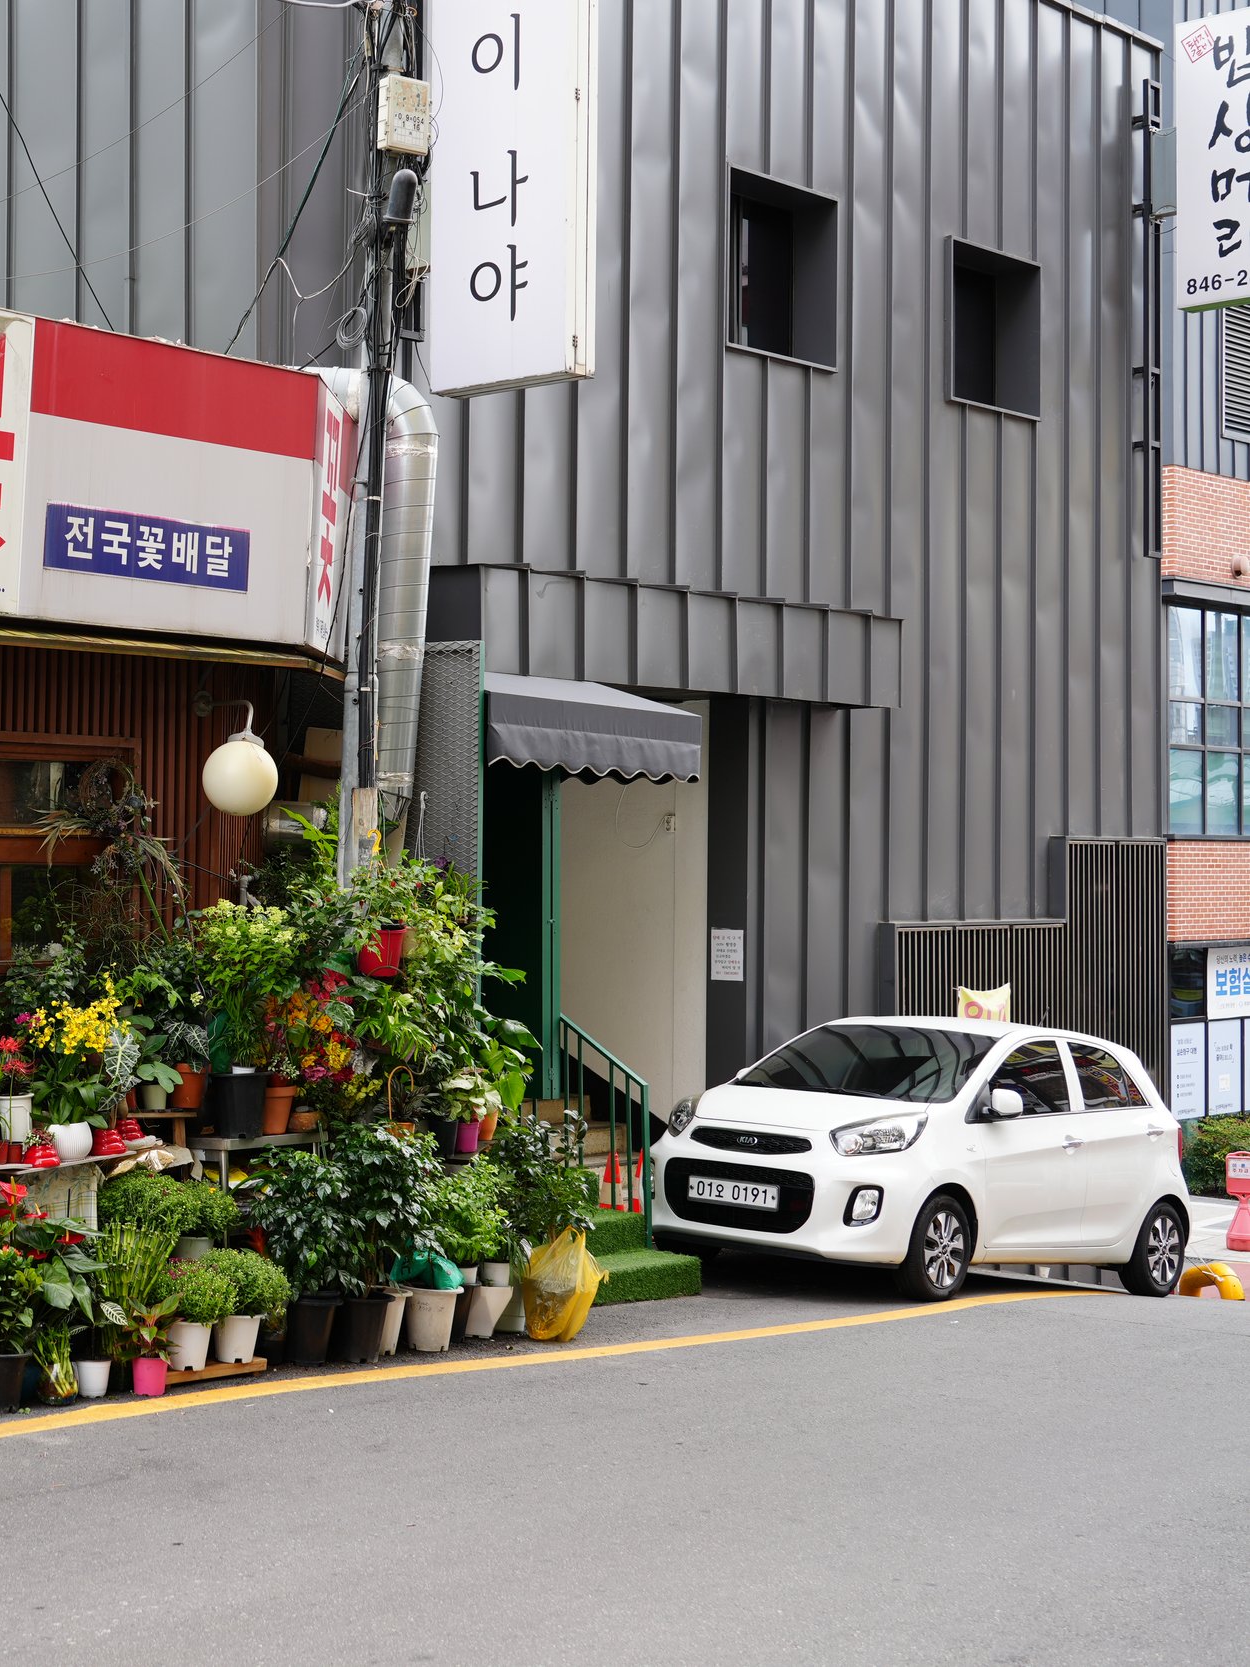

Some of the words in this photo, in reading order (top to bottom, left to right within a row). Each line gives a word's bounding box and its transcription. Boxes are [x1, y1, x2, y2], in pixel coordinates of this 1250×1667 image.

[471, 13, 520, 91] 이
[64, 516, 233, 578] 전국꽃배달
[739, 1136, 754, 1144] KIA
[696, 1180, 725, 1199] 01오
[731, 1184, 768, 1205] 0191
